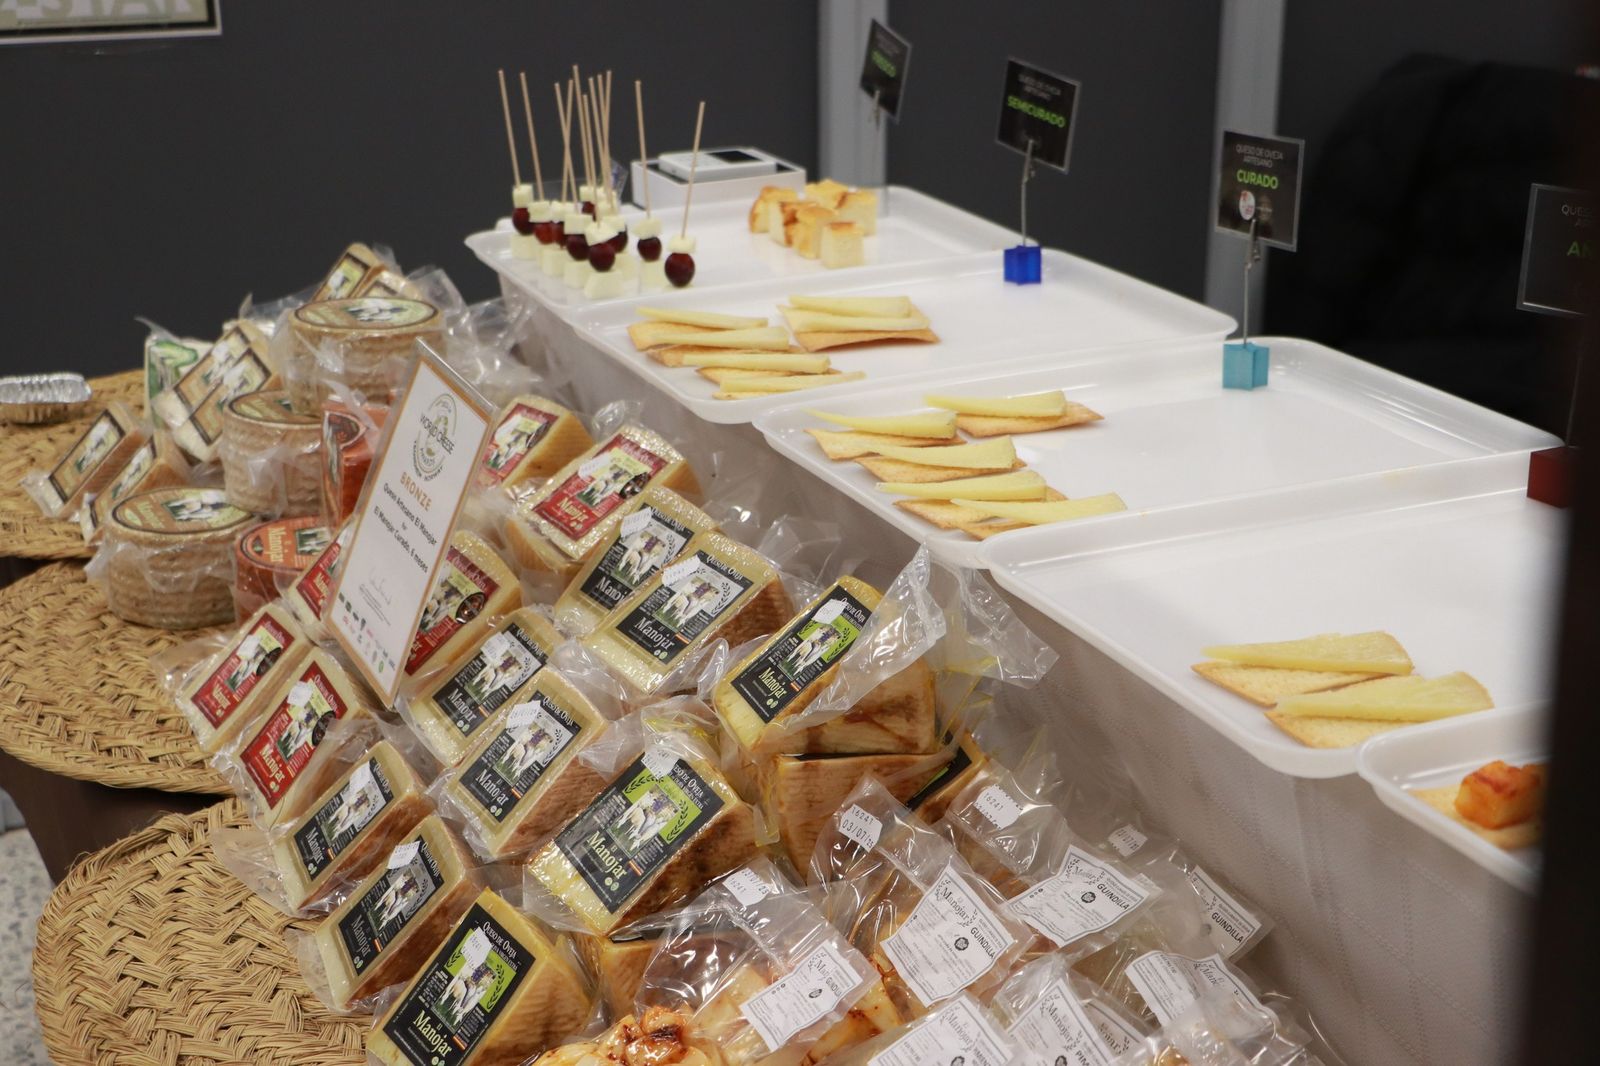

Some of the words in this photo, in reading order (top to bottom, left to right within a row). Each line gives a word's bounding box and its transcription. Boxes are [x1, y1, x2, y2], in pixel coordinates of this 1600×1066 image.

[1008, 96, 1065, 128] SEMICURADO
[1236, 169, 1279, 190] CURADO
[420, 412, 438, 438] WORLD
[436, 430, 456, 455] CHEESE
[400, 471, 432, 512] BRONZE
[263, 527, 287, 562] Manojar
[379, 510, 396, 534] Manojar
[414, 552, 428, 573] meses
[420, 521, 437, 546] Manojar
[634, 616, 675, 651] Manojar
[758, 666, 787, 699] Manojar
[259, 743, 286, 784] Manojar
[475, 769, 509, 806] Manojar
[687, 778, 704, 798] OVEJA
[984, 792, 1003, 811] 16241
[842, 818, 873, 849] 03/07/25
[851, 806, 874, 825] 16241
[305, 826, 324, 866] Manojar
[587, 831, 628, 879] Manojar
[1097, 883, 1130, 911] GUINDILLA
[351, 914, 372, 958] Manojar
[483, 921, 498, 940] QUESO
[502, 940, 517, 959] OVEJA
[941, 887, 970, 923] Manojar
[970, 927, 996, 958] GUINDILLA
[1211, 911, 1244, 943] GUINDILLA
[413, 1009, 452, 1058] Manojar
[947, 1013, 973, 1049] Manojar
[1047, 1003, 1075, 1043] Manojar
